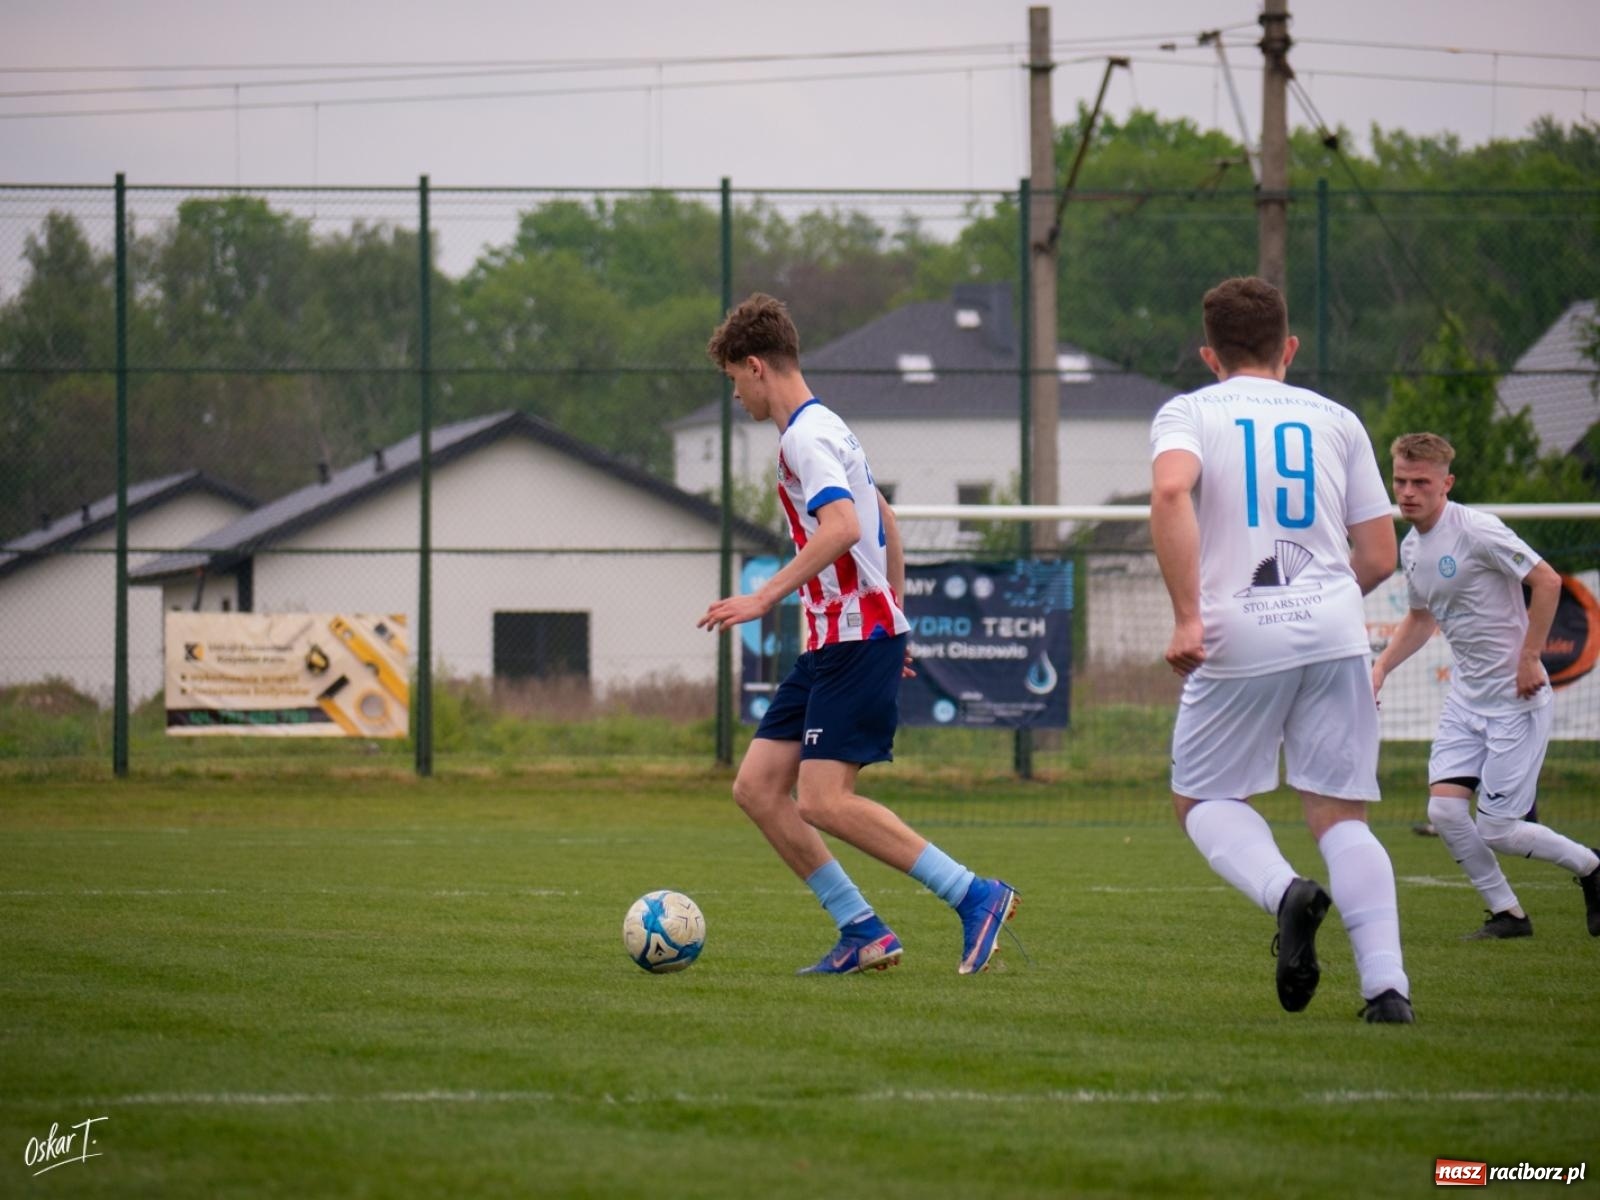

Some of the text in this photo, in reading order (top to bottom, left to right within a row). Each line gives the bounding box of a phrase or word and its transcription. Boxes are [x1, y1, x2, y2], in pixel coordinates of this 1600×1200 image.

[1235, 419, 1315, 529] 19
[1243, 594, 1322, 613] STOLARSTWO
[908, 615, 1047, 638] YDRO TECH
[1257, 609, 1312, 625] ZBECZKA
